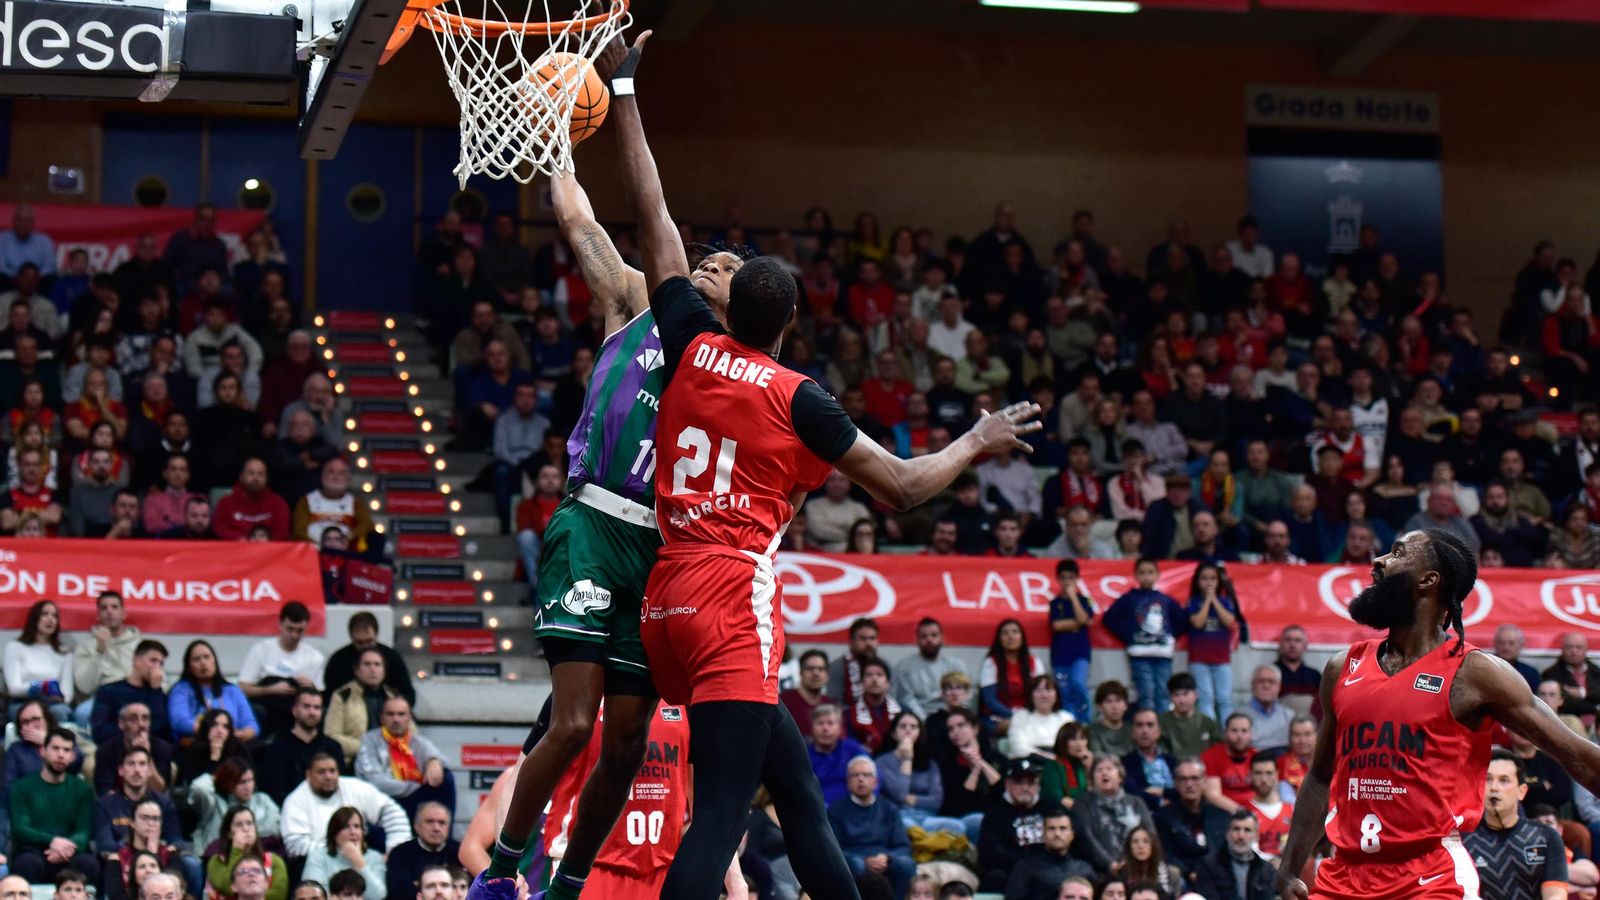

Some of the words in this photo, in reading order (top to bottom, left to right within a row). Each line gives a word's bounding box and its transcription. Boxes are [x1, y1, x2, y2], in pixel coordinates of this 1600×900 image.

[1255, 92, 1345, 119] Grada
[1356, 96, 1431, 122] Norte
[692, 343, 777, 389] DIAGNE
[630, 439, 657, 484] 11
[672, 425, 738, 496] 21
[57, 571, 110, 598] DE
[121, 576, 282, 602] MURCIA
[648, 740, 679, 769] AM
[1342, 720, 1427, 760] UCAM
[1348, 752, 1409, 774] MURCIA
[1360, 778, 1392, 786] CARAVACA
[626, 810, 664, 845] 00
[1360, 813, 1382, 854] 8
